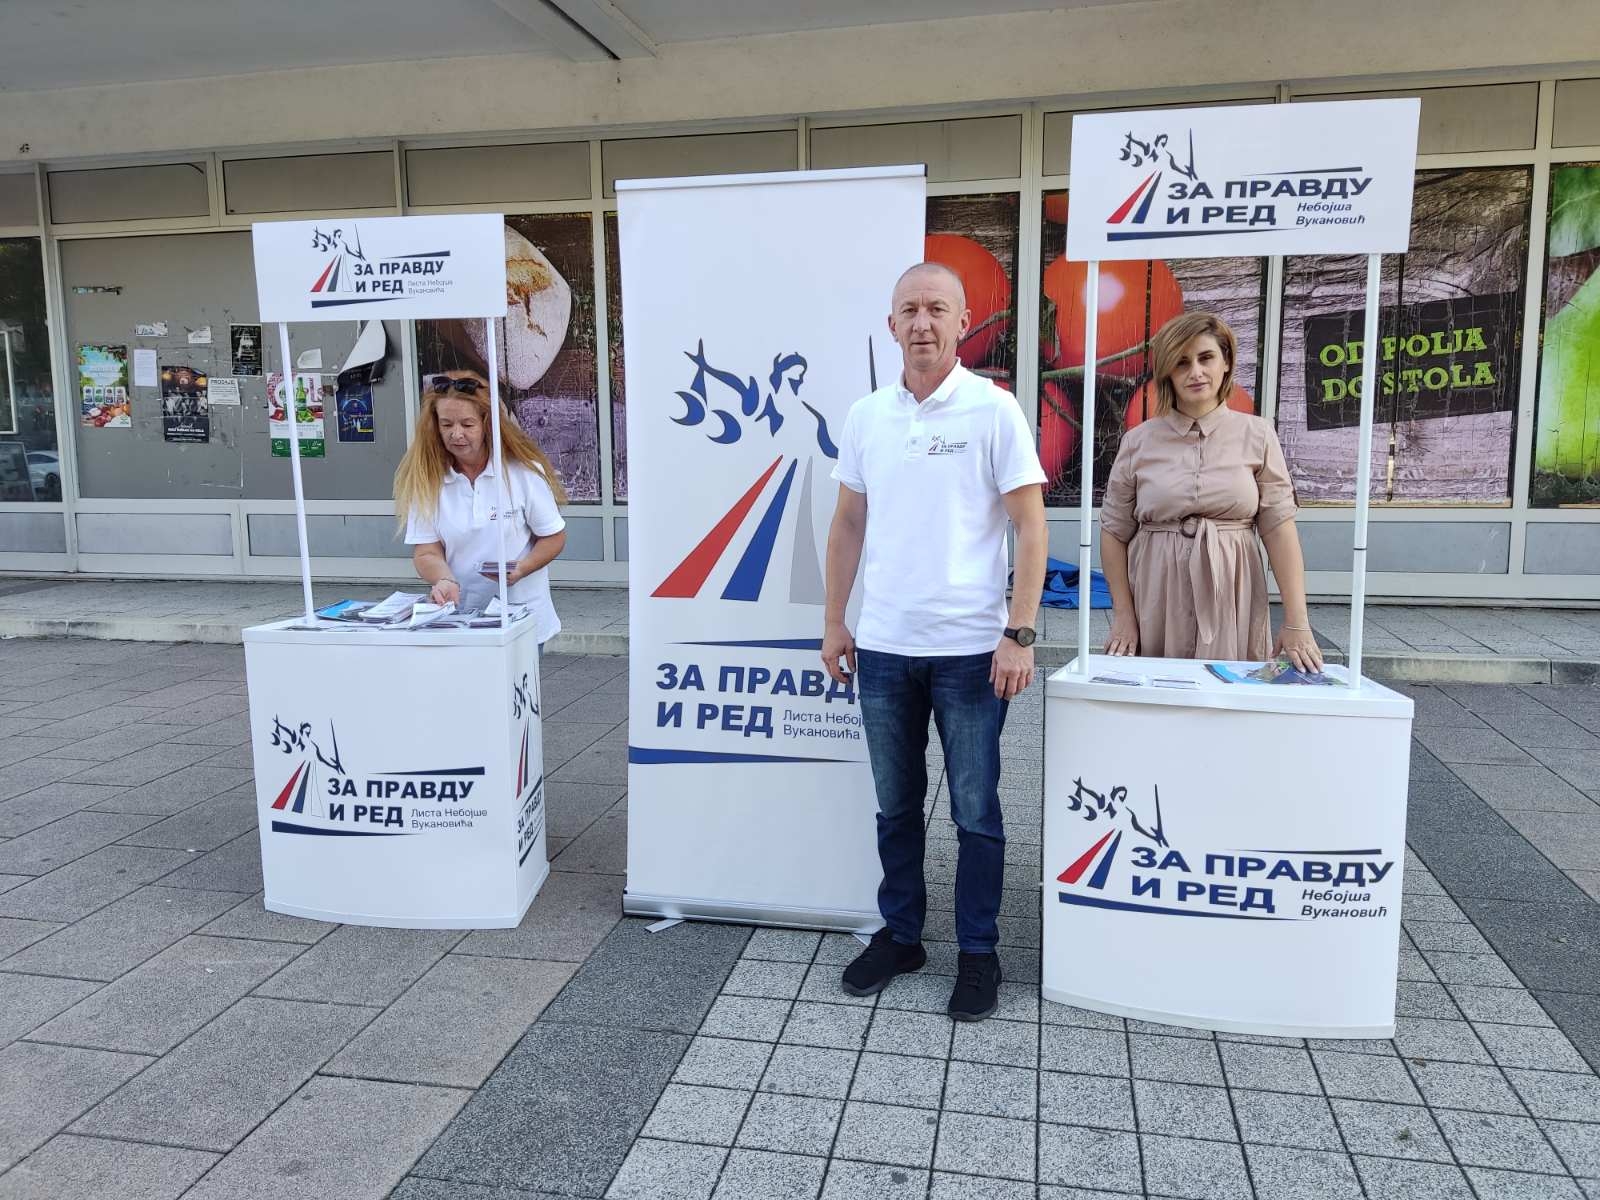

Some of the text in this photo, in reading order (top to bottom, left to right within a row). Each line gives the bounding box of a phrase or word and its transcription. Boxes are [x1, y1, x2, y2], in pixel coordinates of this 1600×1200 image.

[1167, 177, 1373, 200] ЗА ПРАВДУ
[1166, 204, 1277, 226] И РЕД
[1297, 202, 1352, 213] Небојша
[1295, 215, 1366, 226] Вукановић
[354, 260, 444, 276] ЗА ПРАВДУ
[355, 279, 404, 294] И РЕД
[1382, 327, 1487, 361] POLJA
[1383, 362, 1496, 395] STOLA
[656, 663, 858, 704] ЗА ПРАВД
[656, 702, 774, 738] И РЕД
[783, 709, 864, 727] Листа Небој
[783, 725, 860, 740] Вукановића
[327, 777, 474, 802] ЗА ПРАВДУ
[329, 804, 403, 827] И РЕД
[410, 808, 488, 819] Листа Небојше
[411, 819, 473, 829] Вукановића
[1131, 846, 1394, 887] ЗА ПРАВДУ
[1132, 875, 1275, 914] И РЕД
[1301, 889, 1371, 902] Небојша
[1301, 905, 1387, 918] Вукановић
